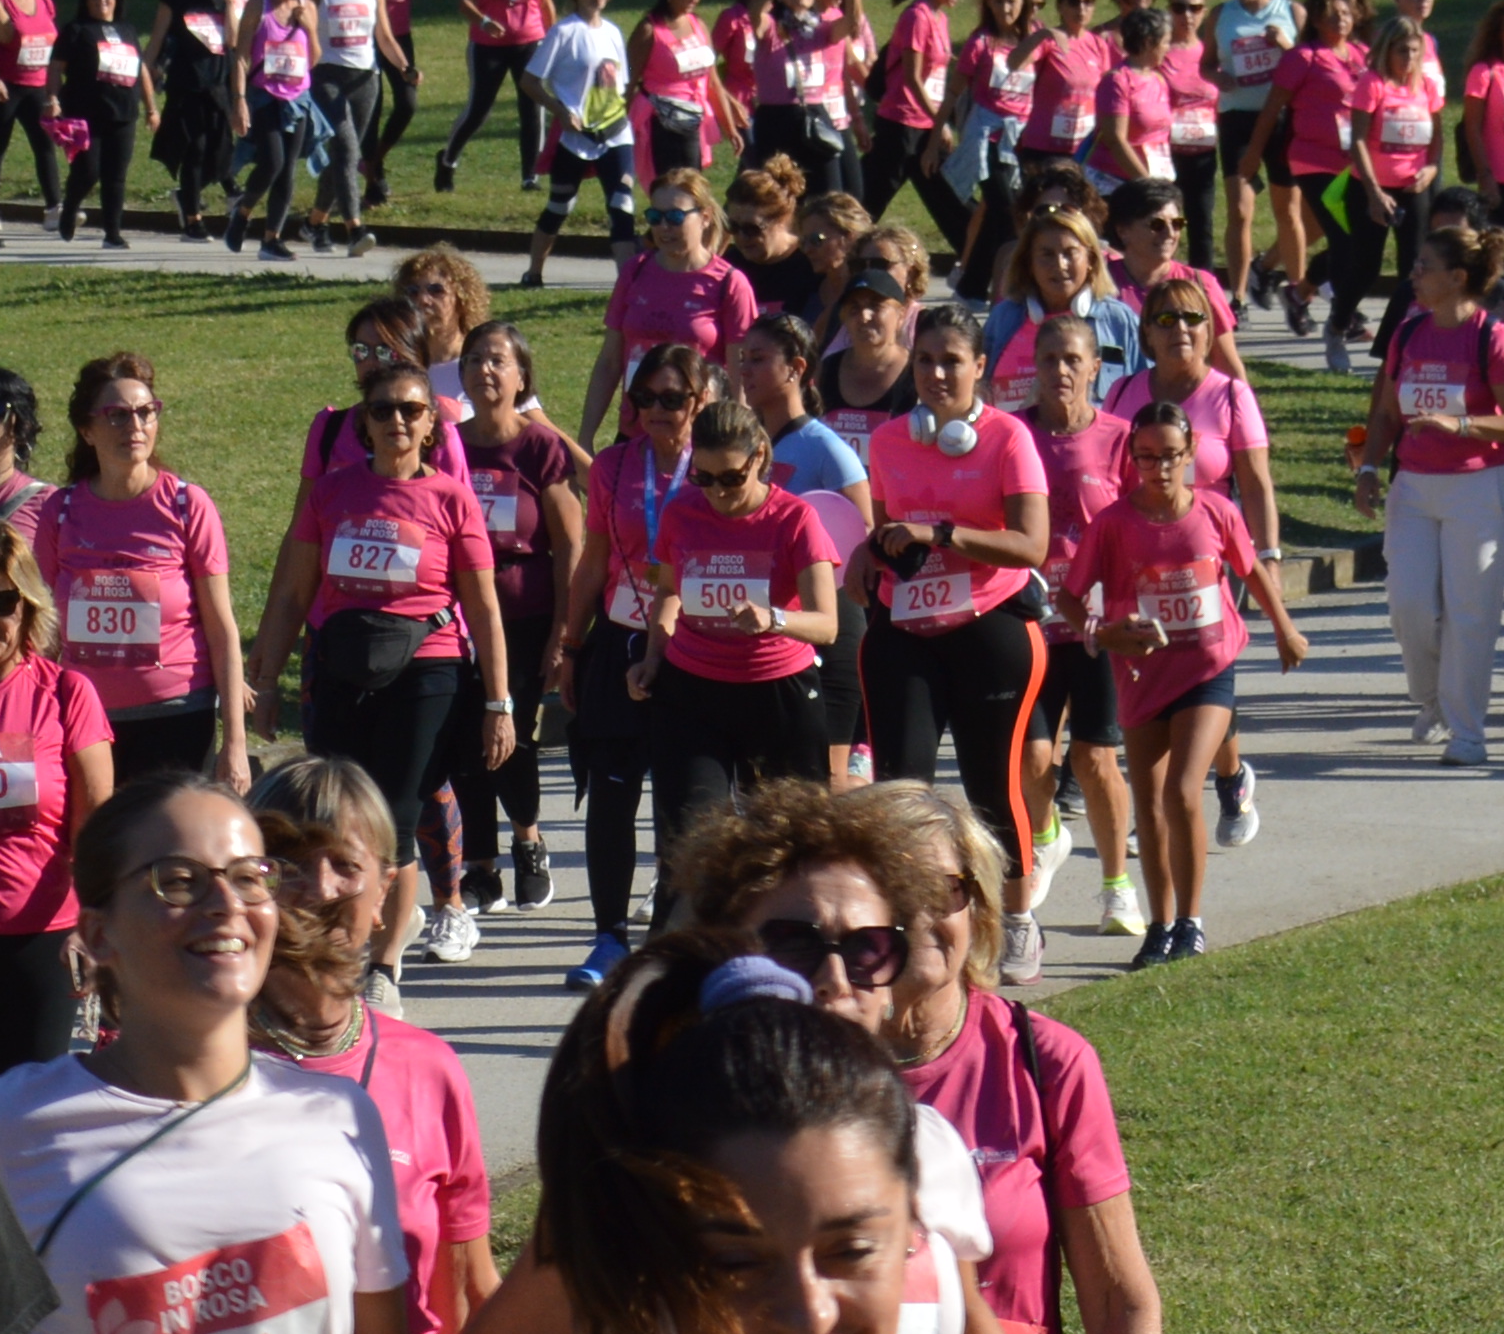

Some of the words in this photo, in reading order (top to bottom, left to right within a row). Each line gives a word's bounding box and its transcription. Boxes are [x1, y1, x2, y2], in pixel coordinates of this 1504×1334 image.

[1412, 388, 1448, 410] 265
[359, 526, 371, 537] IN
[372, 528, 399, 540] ROSA
[365, 519, 399, 533] BOSCO
[347, 543, 397, 572] 827
[706, 565, 717, 575] IN
[718, 565, 746, 575] ROSA
[710, 555, 745, 566] BOSCO
[91, 587, 103, 598] IN
[105, 587, 134, 599] ROSA
[94, 575, 131, 588] BOSCO
[701, 582, 747, 610] 509
[907, 580, 951, 611] 262
[86, 606, 137, 635] 830
[1157, 594, 1204, 623] 502
[163, 1257, 253, 1305] BOSCO
[196, 1284, 268, 1327] ROSA
